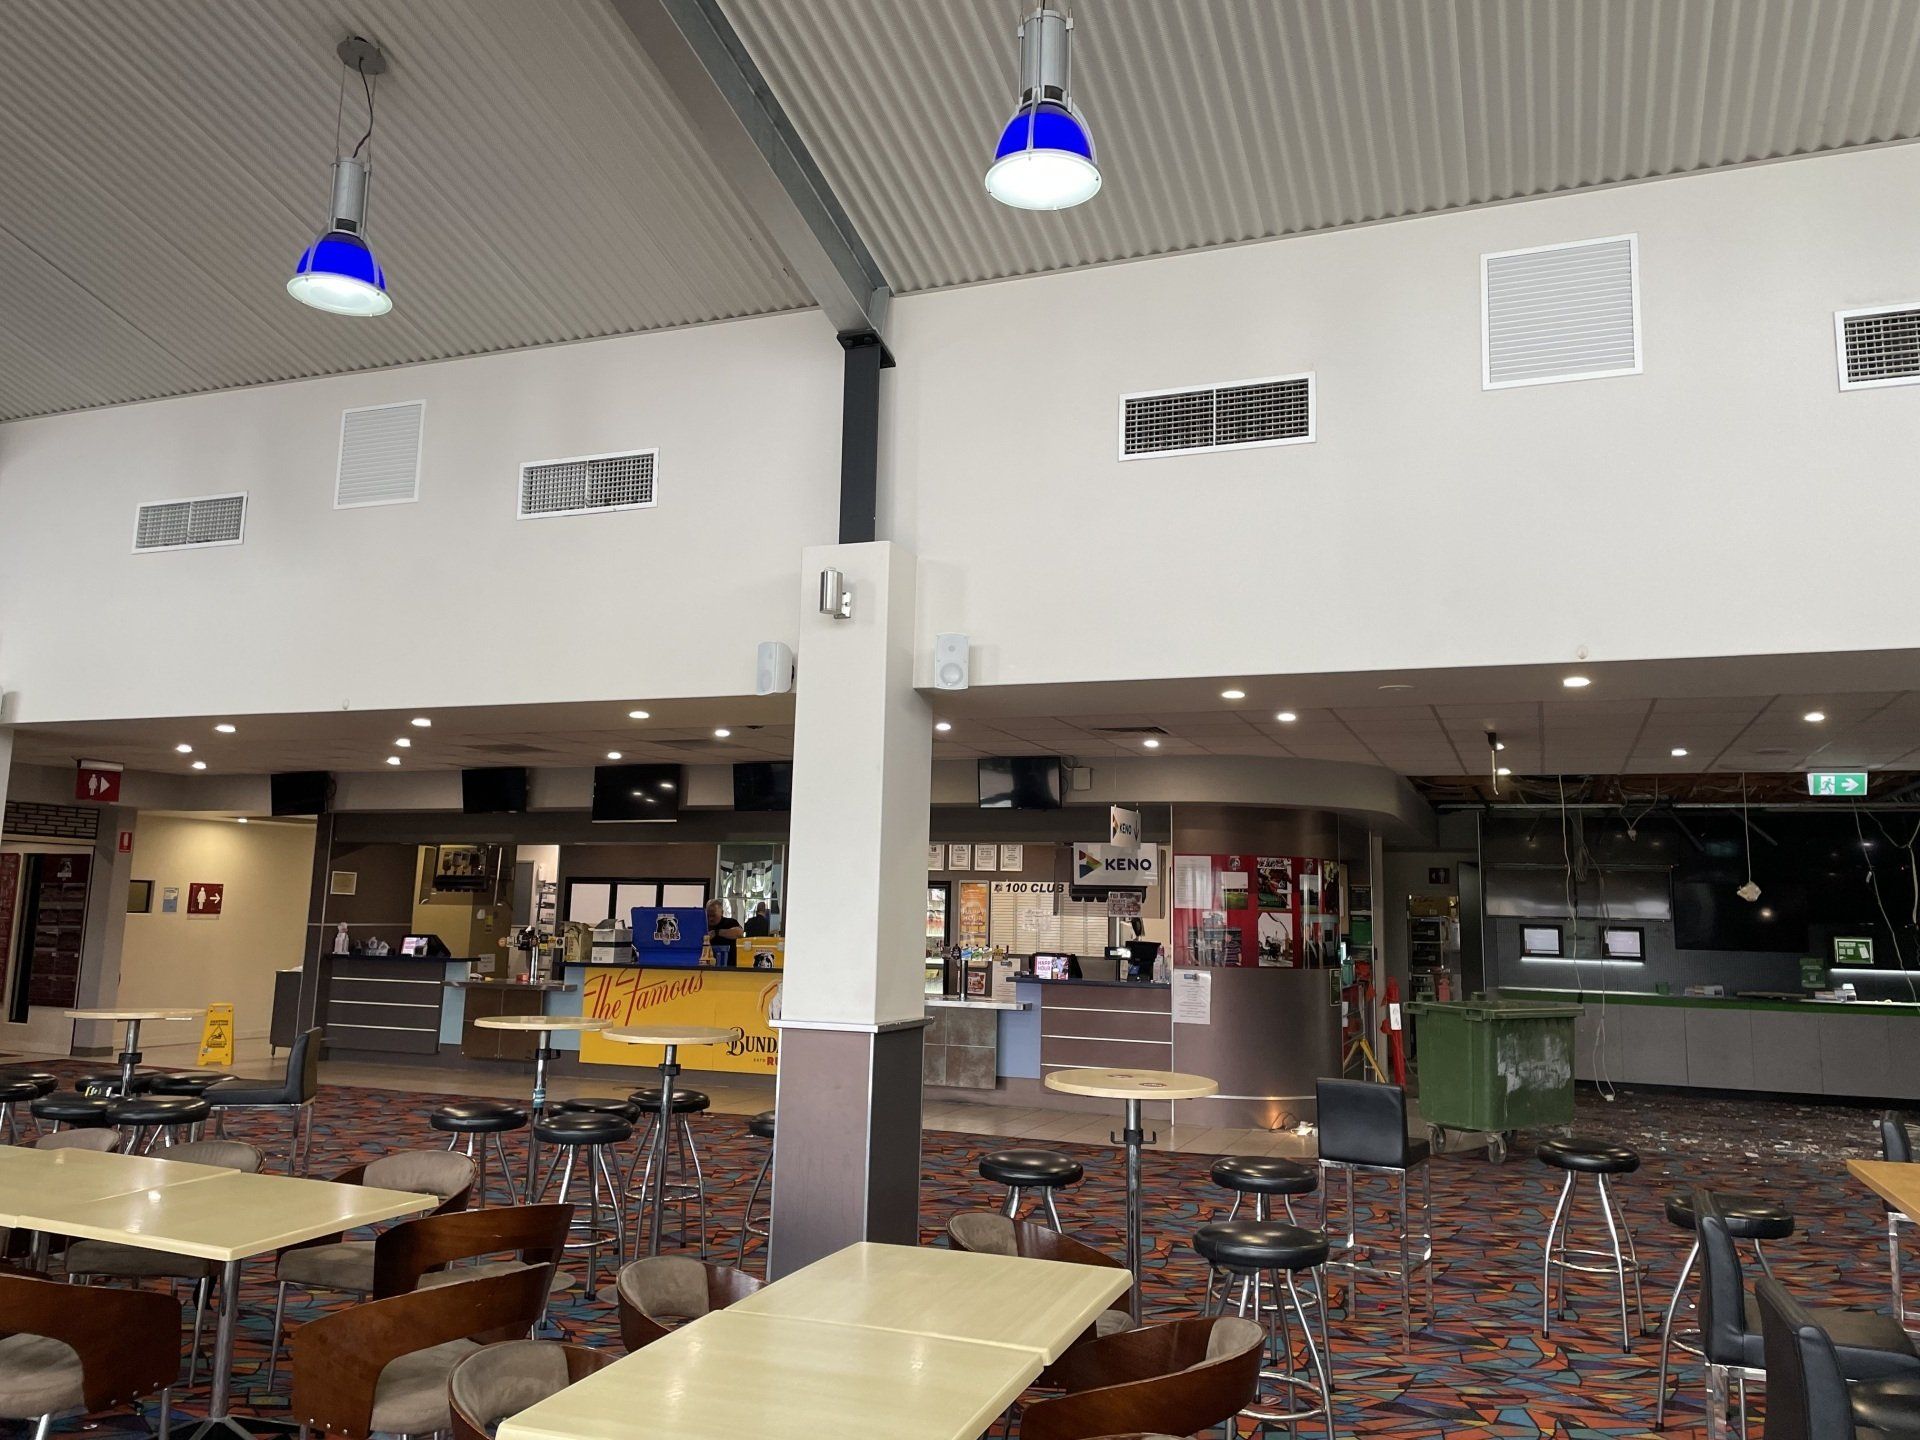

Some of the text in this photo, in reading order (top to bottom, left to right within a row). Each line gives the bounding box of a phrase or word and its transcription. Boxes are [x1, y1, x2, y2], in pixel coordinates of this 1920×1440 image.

[1120, 823, 1132, 835] KENO
[1105, 858, 1152, 871] KENO
[1005, 883, 1064, 893] 100 CLUB
[584, 967, 704, 1027] The Famous
[725, 1026, 779, 1057] BUND
